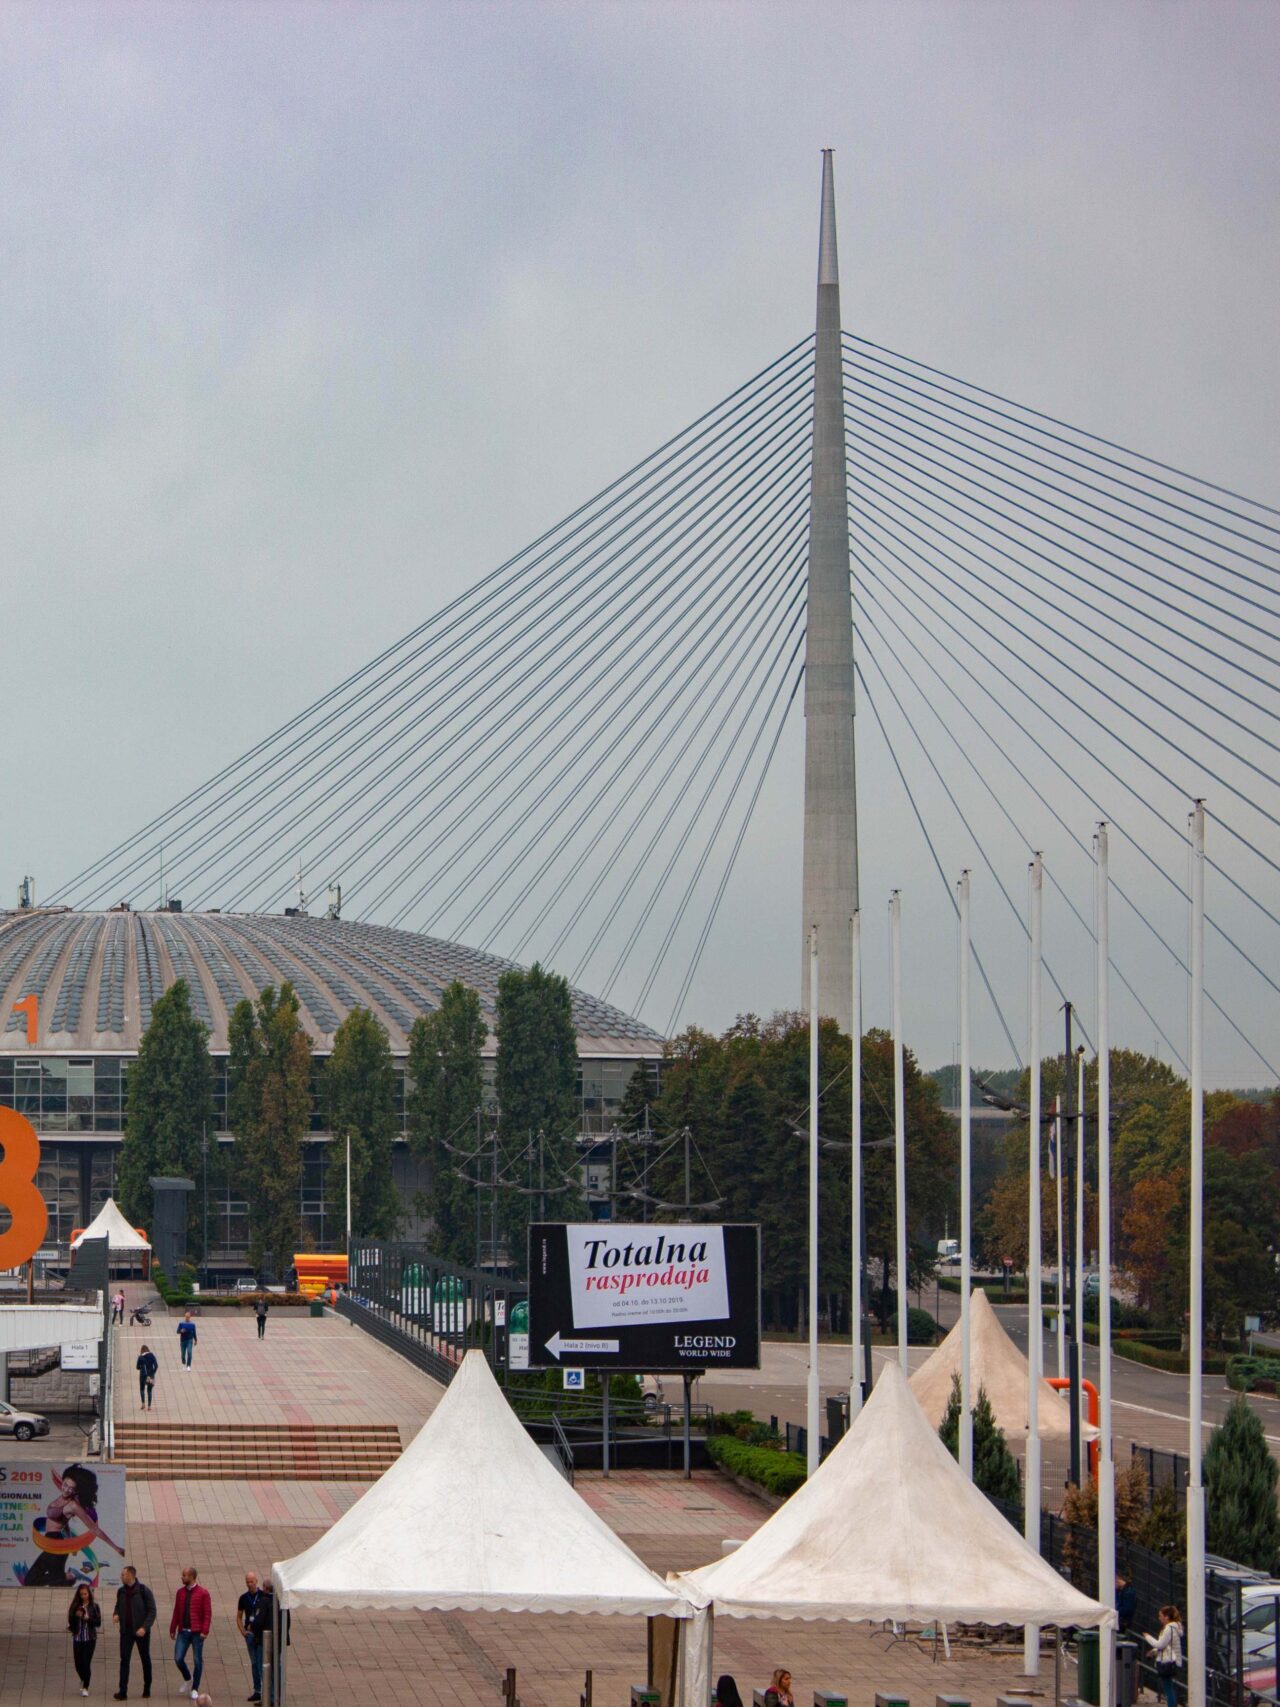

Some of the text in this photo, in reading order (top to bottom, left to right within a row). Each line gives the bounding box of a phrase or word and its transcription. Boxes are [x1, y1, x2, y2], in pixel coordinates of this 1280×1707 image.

[12, 994, 39, 1044] 1
[583, 1235, 708, 1270] Totalna
[585, 1263, 710, 1294] rasprodaja
[564, 1341, 578, 1349] Hala
[674, 1335, 736, 1348] LEGEND
[679, 1349, 731, 1357] WORLD WIDE
[10, 1471, 43, 1482] 2019
